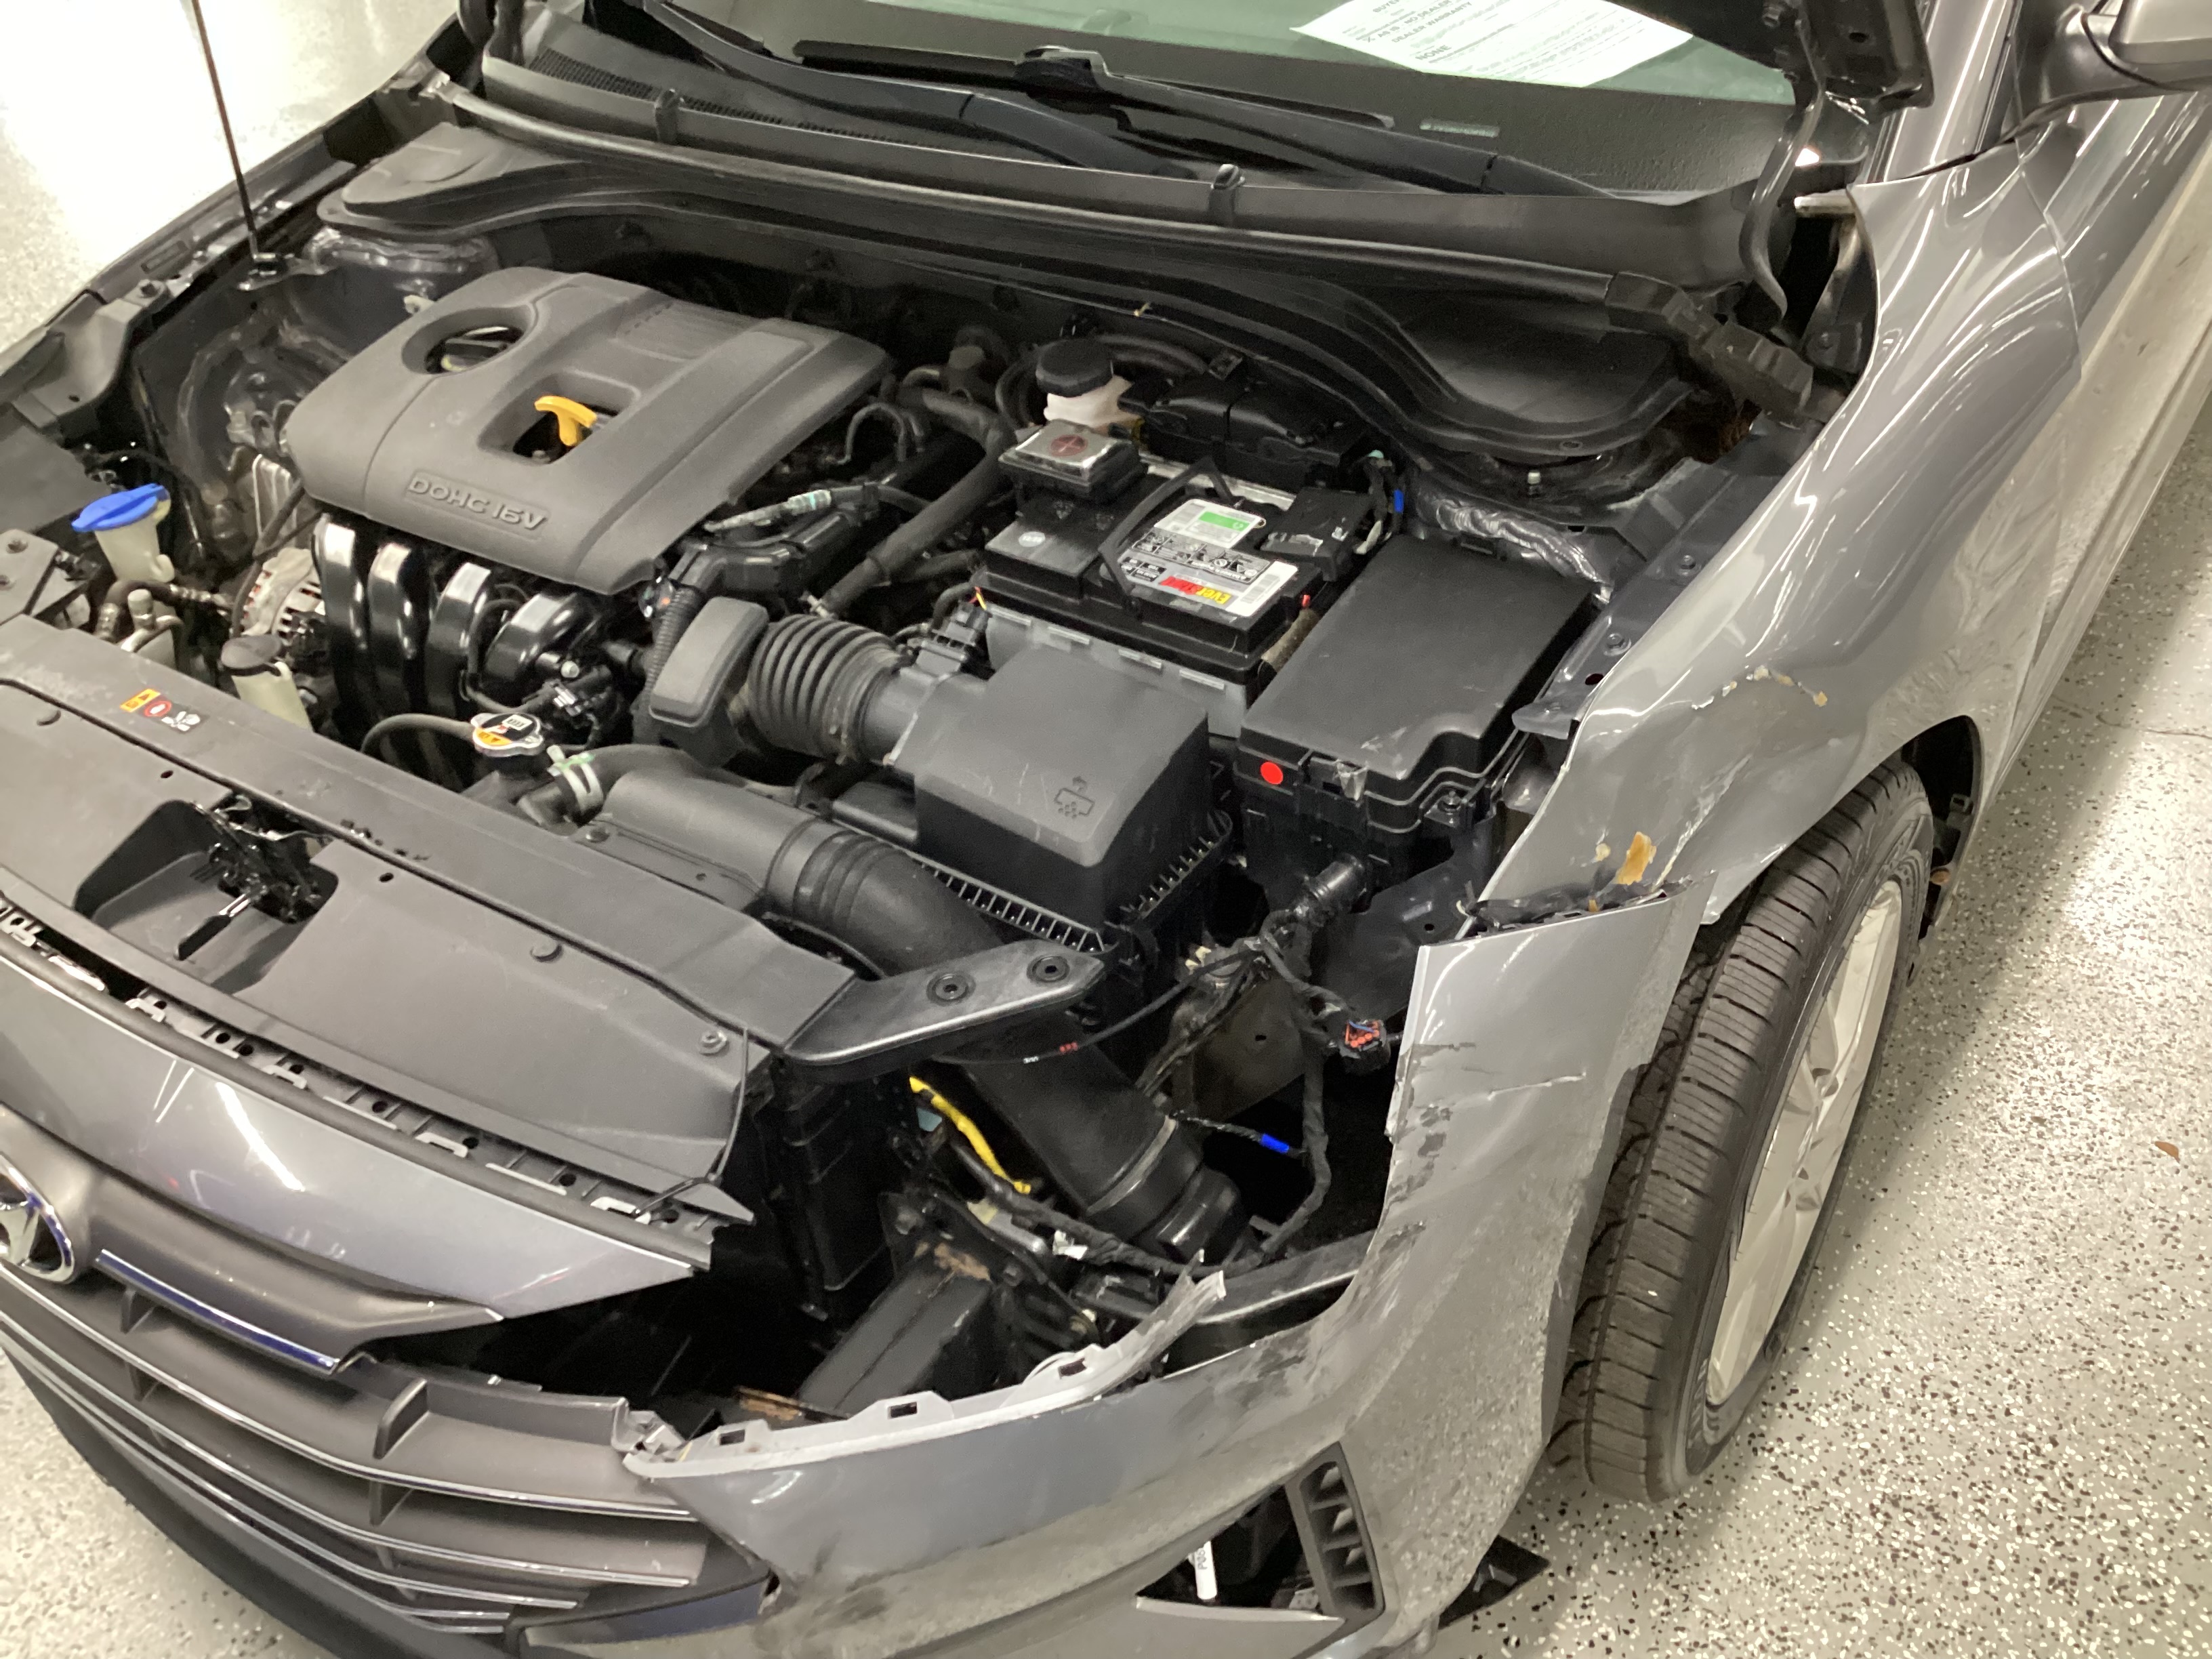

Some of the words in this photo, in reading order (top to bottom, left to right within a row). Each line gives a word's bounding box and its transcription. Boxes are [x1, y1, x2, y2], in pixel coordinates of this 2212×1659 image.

[1391, 25, 1427, 43] DEALER
[1425, 1, 1473, 25] WARRANTY
[1415, 45, 1452, 60] NONE
[408, 478, 490, 514] DOHC
[492, 503, 548, 531] 16V
